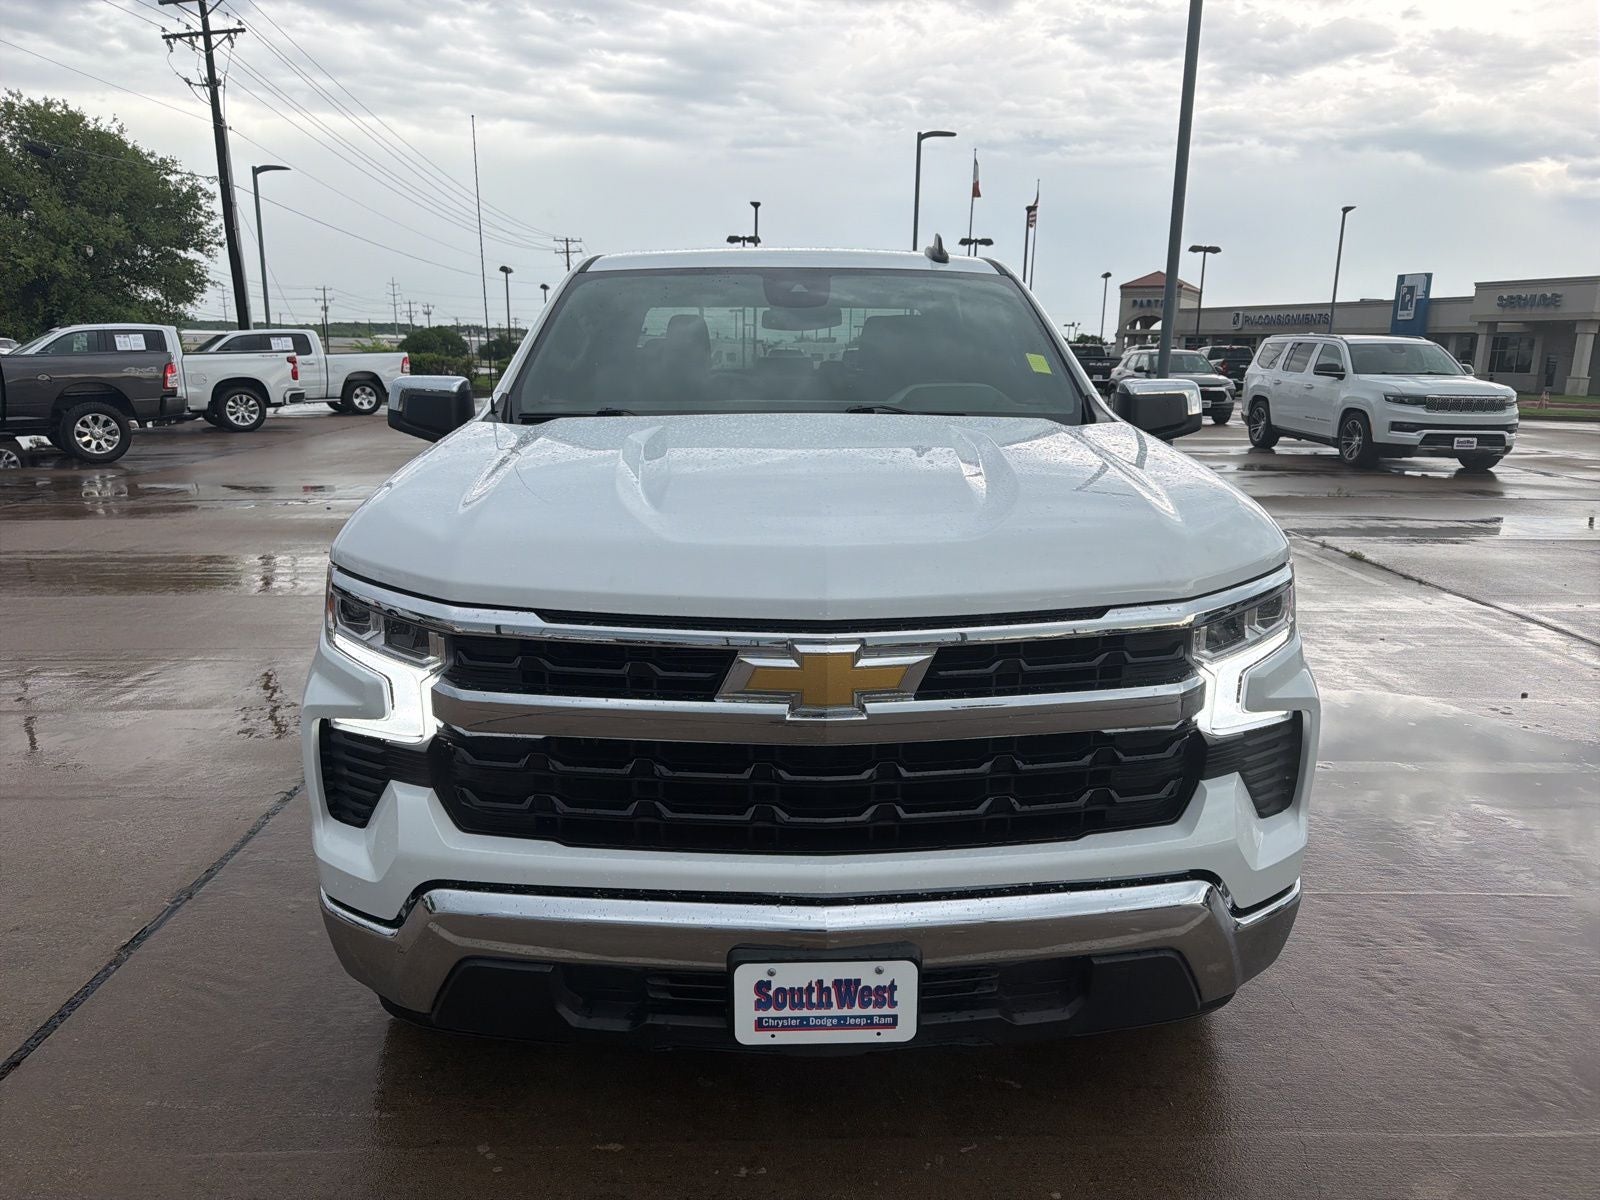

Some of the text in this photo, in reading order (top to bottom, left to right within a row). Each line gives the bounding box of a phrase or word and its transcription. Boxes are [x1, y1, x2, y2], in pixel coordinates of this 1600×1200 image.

[1497, 293, 1562, 308] SERVICE
[754, 979, 898, 1011] SouthWest
[762, 1016, 893, 1027] Chrysler Dodge Jeep Ram
